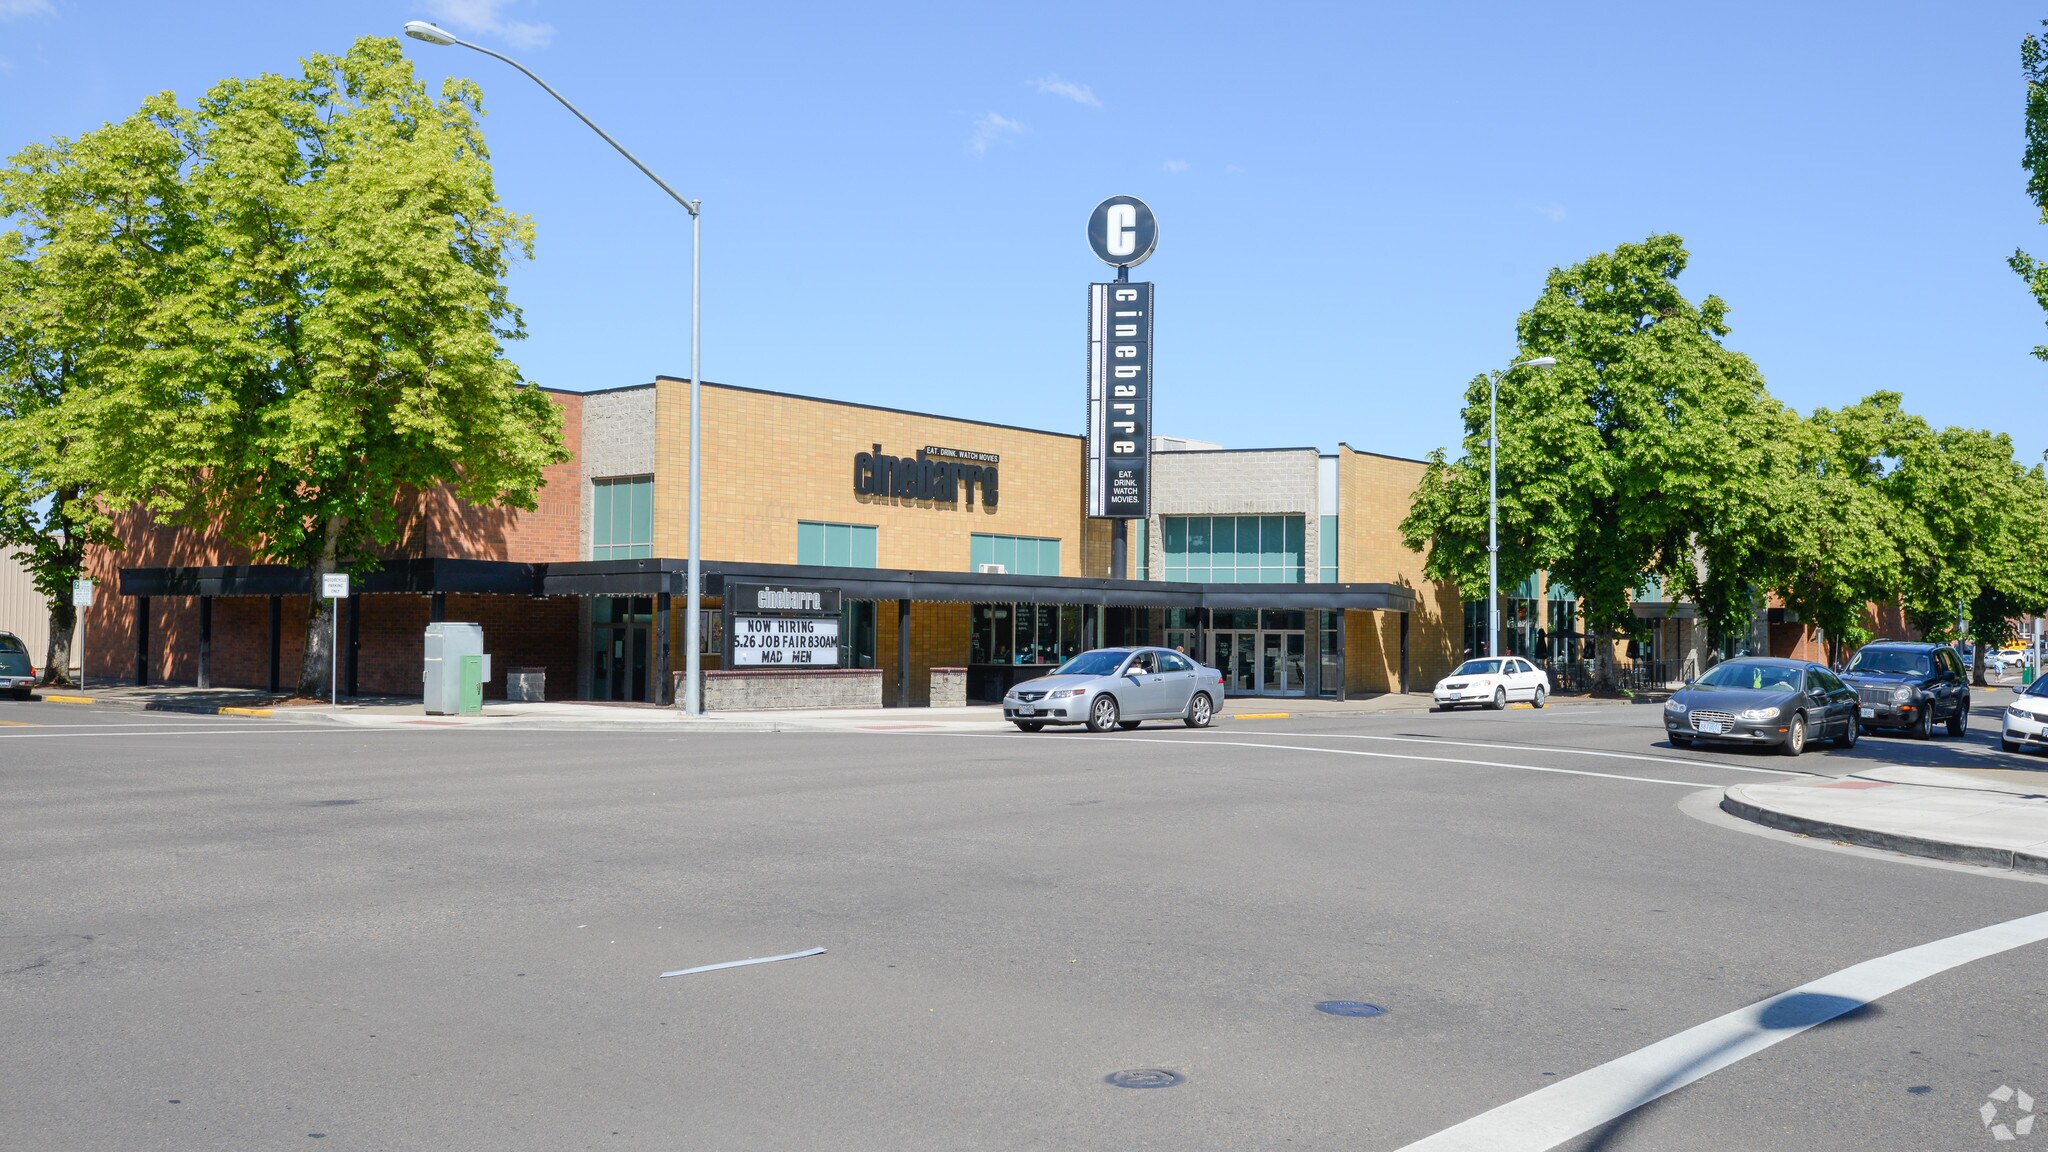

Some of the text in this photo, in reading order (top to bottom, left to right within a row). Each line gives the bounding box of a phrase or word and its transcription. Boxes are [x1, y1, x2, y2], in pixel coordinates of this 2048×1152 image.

[1107, 204, 1136, 256] C
[1114, 289, 1142, 453] cinebarre
[927, 447, 939, 455] EAT.
[941, 449, 957, 457] DRINK.
[959, 451, 978, 459] WATCH
[854, 443, 999, 506] cinebarre
[1119, 470, 1133, 478] EAT.
[1114, 479, 1138, 487] DRINK.
[1113, 487, 1138, 495] WATCH
[1111, 495, 1140, 503] MOVIES.
[748, 620, 814, 633] NOW HIRING
[734, 635, 838, 648] 5.26 JOB FAIR 830AM
[761, 650, 812, 663] MAD MEN
